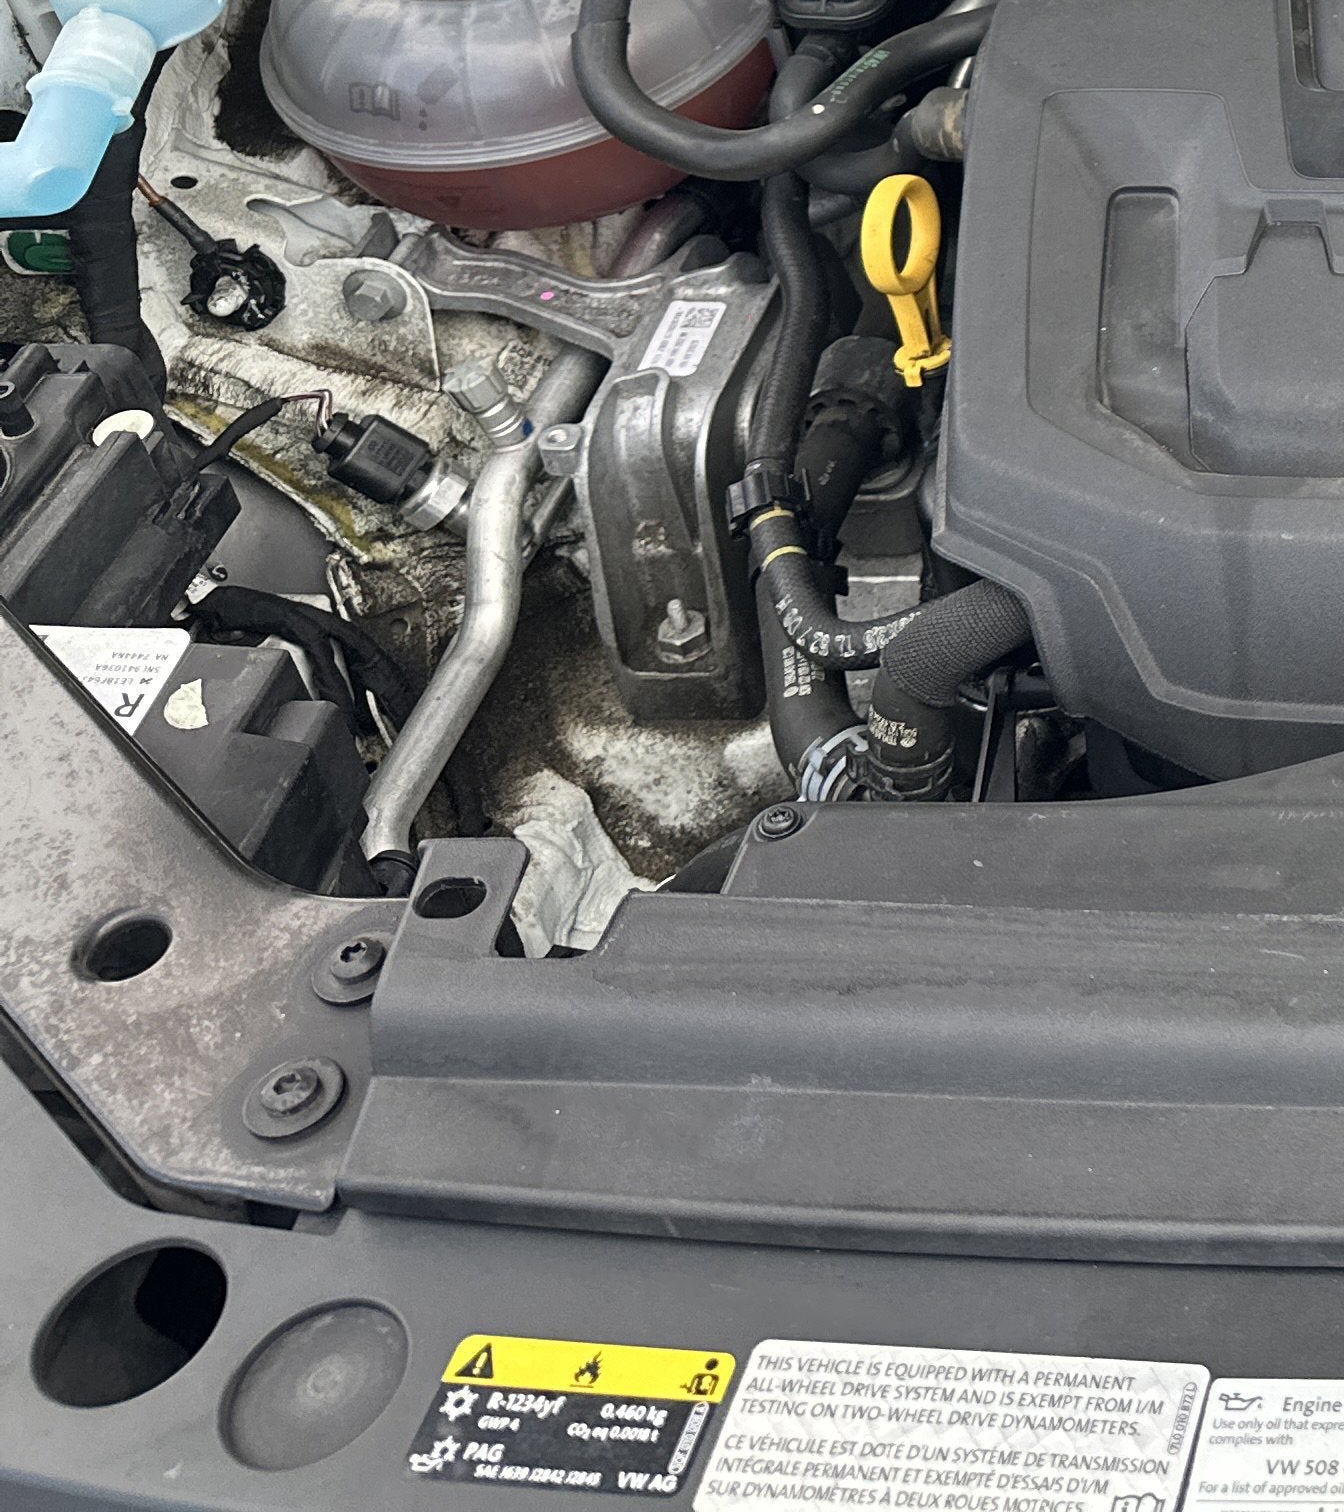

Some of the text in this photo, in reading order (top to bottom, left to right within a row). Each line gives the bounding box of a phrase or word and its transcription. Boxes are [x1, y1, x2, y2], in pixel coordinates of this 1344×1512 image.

[114, 692, 145, 718] R
[757, 1355, 1136, 1389] THIS VEHICLE IS EQUIPPED WITH A PERMANENT
[486, 1392, 669, 1427] R-1234yf 0.460 kg
[746, 1377, 1165, 1416] ALL-WHEEL DRIVE SYSTEM AND IS EXEMPT FROM I/M
[1282, 1396, 1343, 1417] Engine
[739, 1398, 1141, 1436] TESTING ON TWO-WHEEL DRIVE DYNAMOMETERS.
[1212, 1418, 1236, 1430] Use
[1237, 1418, 1265, 1433] only
[1266, 1418, 1282, 1430] oil
[1284, 1419, 1309, 1431] that
[462, 1441, 505, 1463] PAG
[1209, 1433, 1294, 1448] complies with
[724, 1433, 1171, 1475] CE VÉHICULE EST D'UN DE TRANSMISSION
[1266, 1458, 1300, 1476] VW
[1304, 1459, 1340, 1476] 508
[617, 1472, 679, 1493] VW AG
[715, 1455, 1065, 1492] INTÉGRALE PERMANENT ET EXEMPTÉ D'ESSAIS
[706, 1480, 1000, 1511] SUR DYNAMOMÈTRES DEUX ROUES
[1198, 1480, 1328, 1497] For list approved
